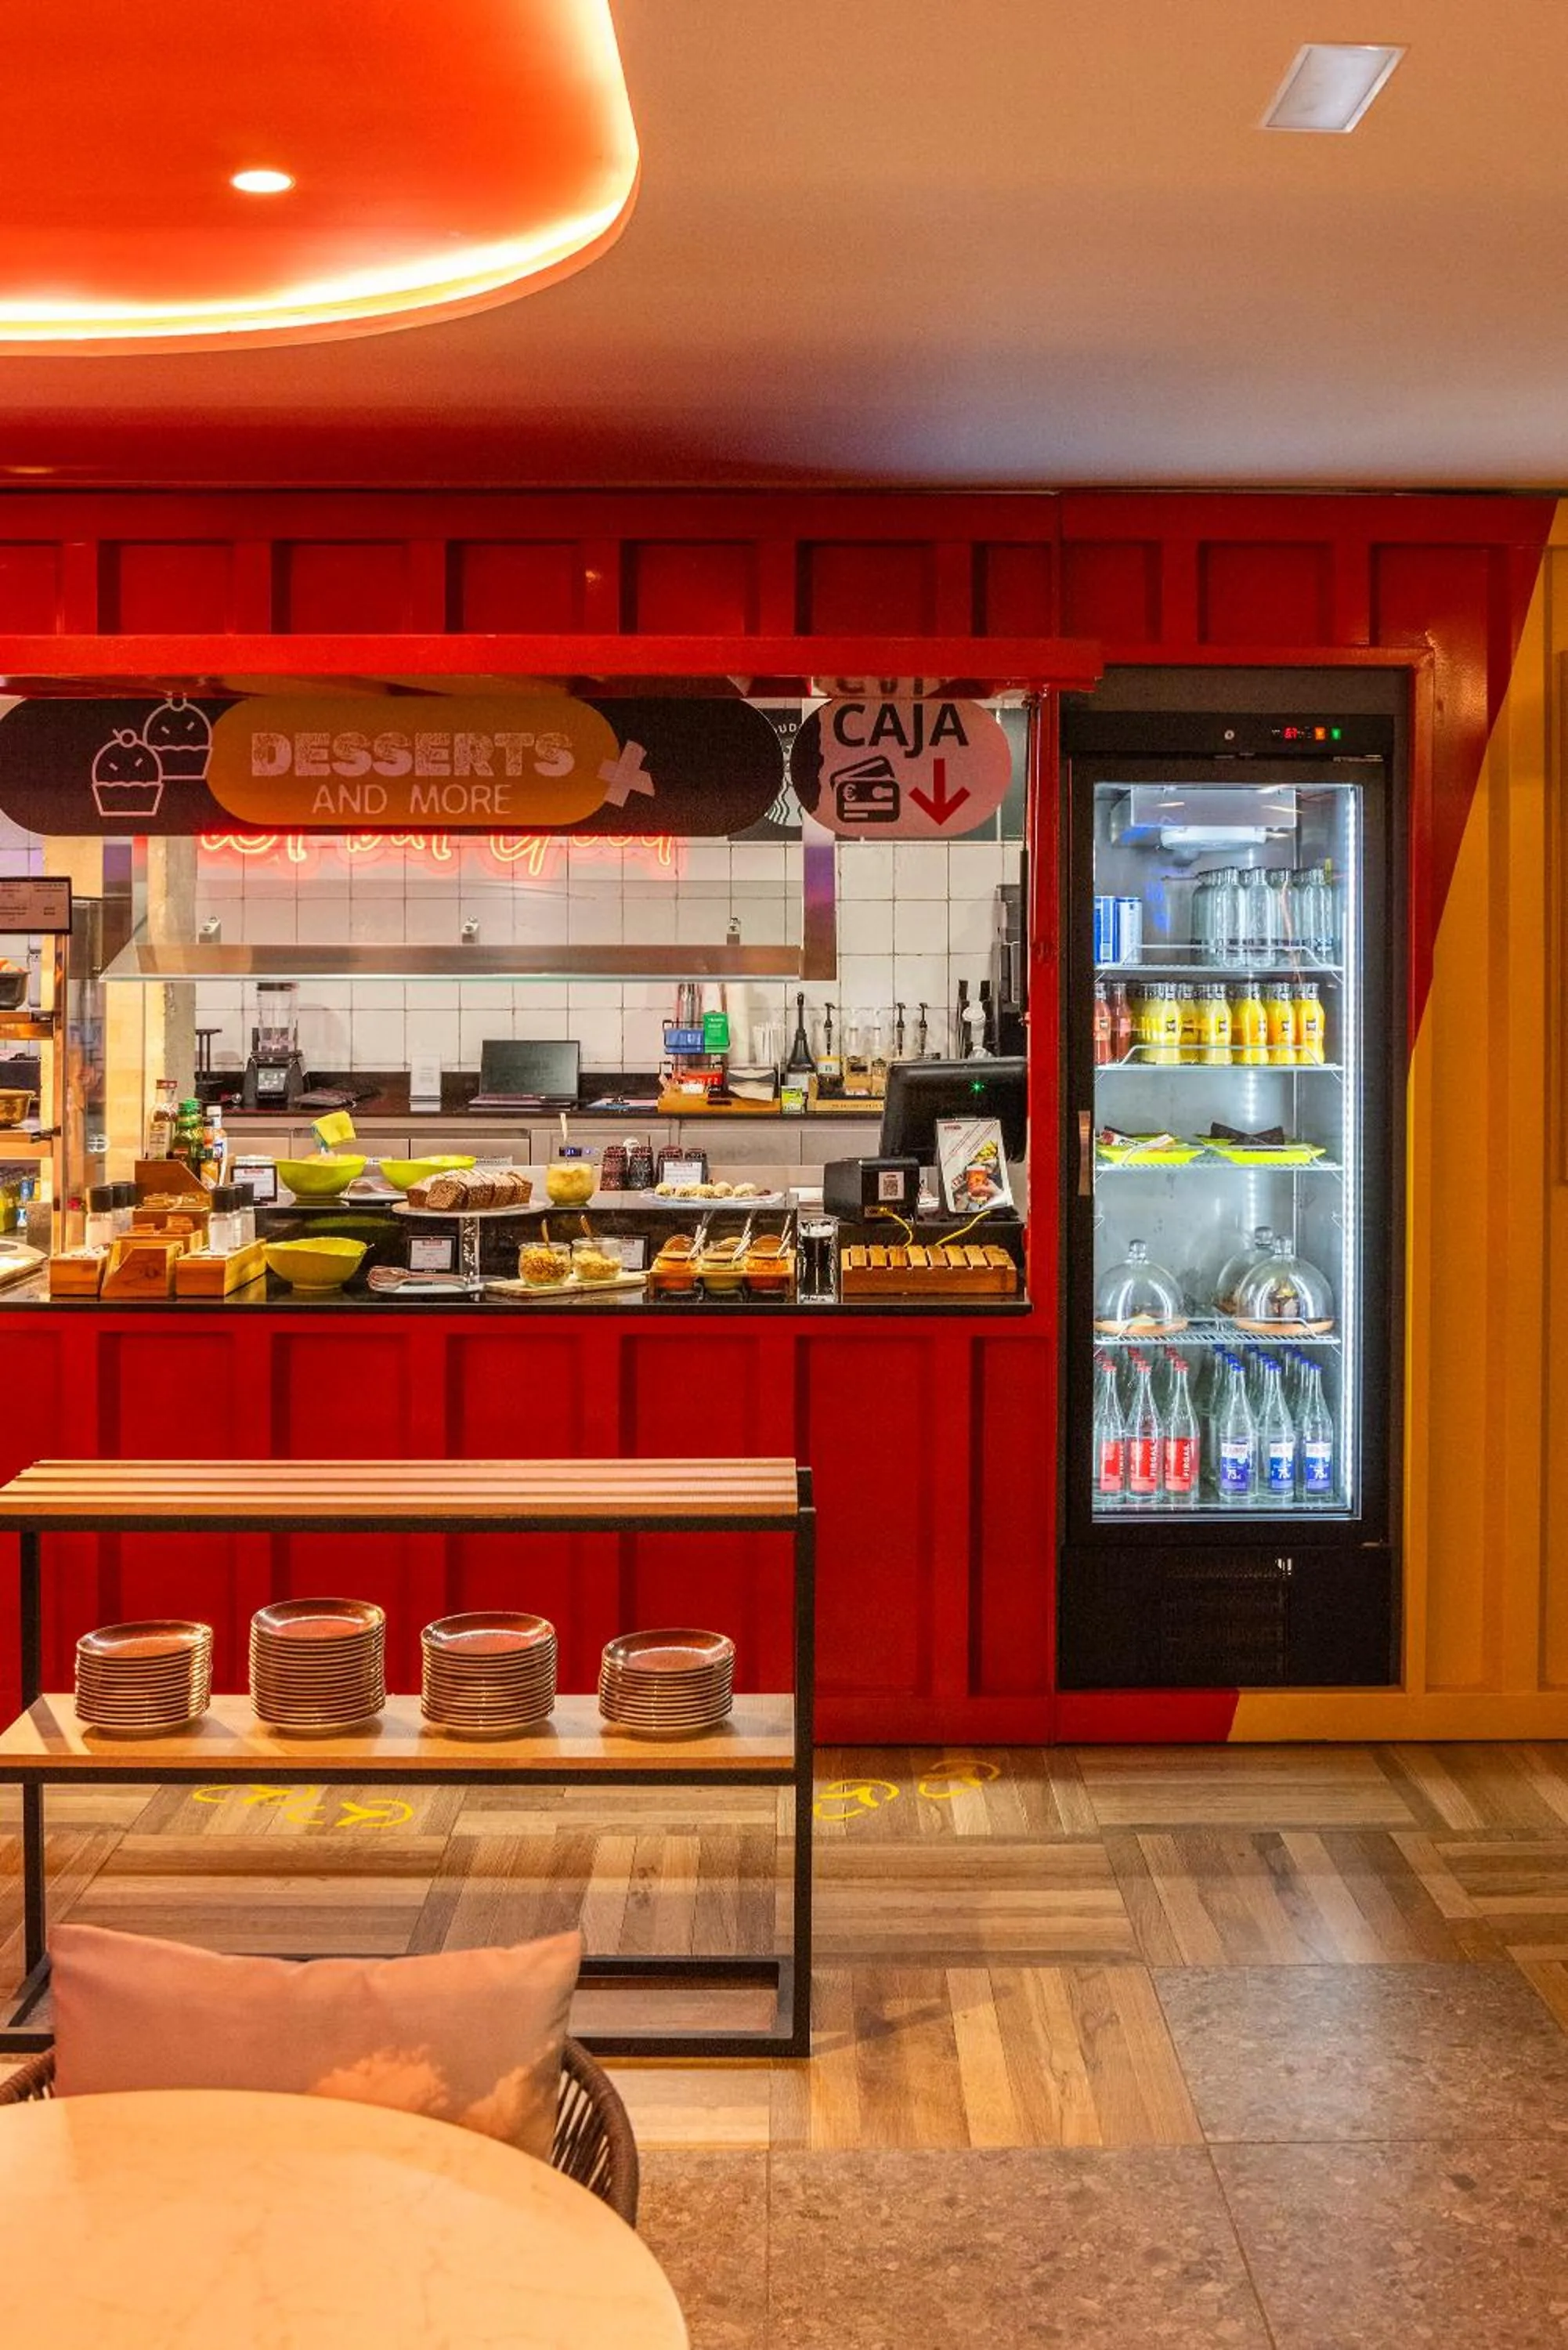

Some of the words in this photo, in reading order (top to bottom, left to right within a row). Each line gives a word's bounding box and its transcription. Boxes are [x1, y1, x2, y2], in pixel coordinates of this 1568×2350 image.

[833, 703, 969, 758] CAJA
[251, 732, 575, 777] DESSERTS
[313, 785, 388, 815] AND
[410, 784, 512, 815] MORE
